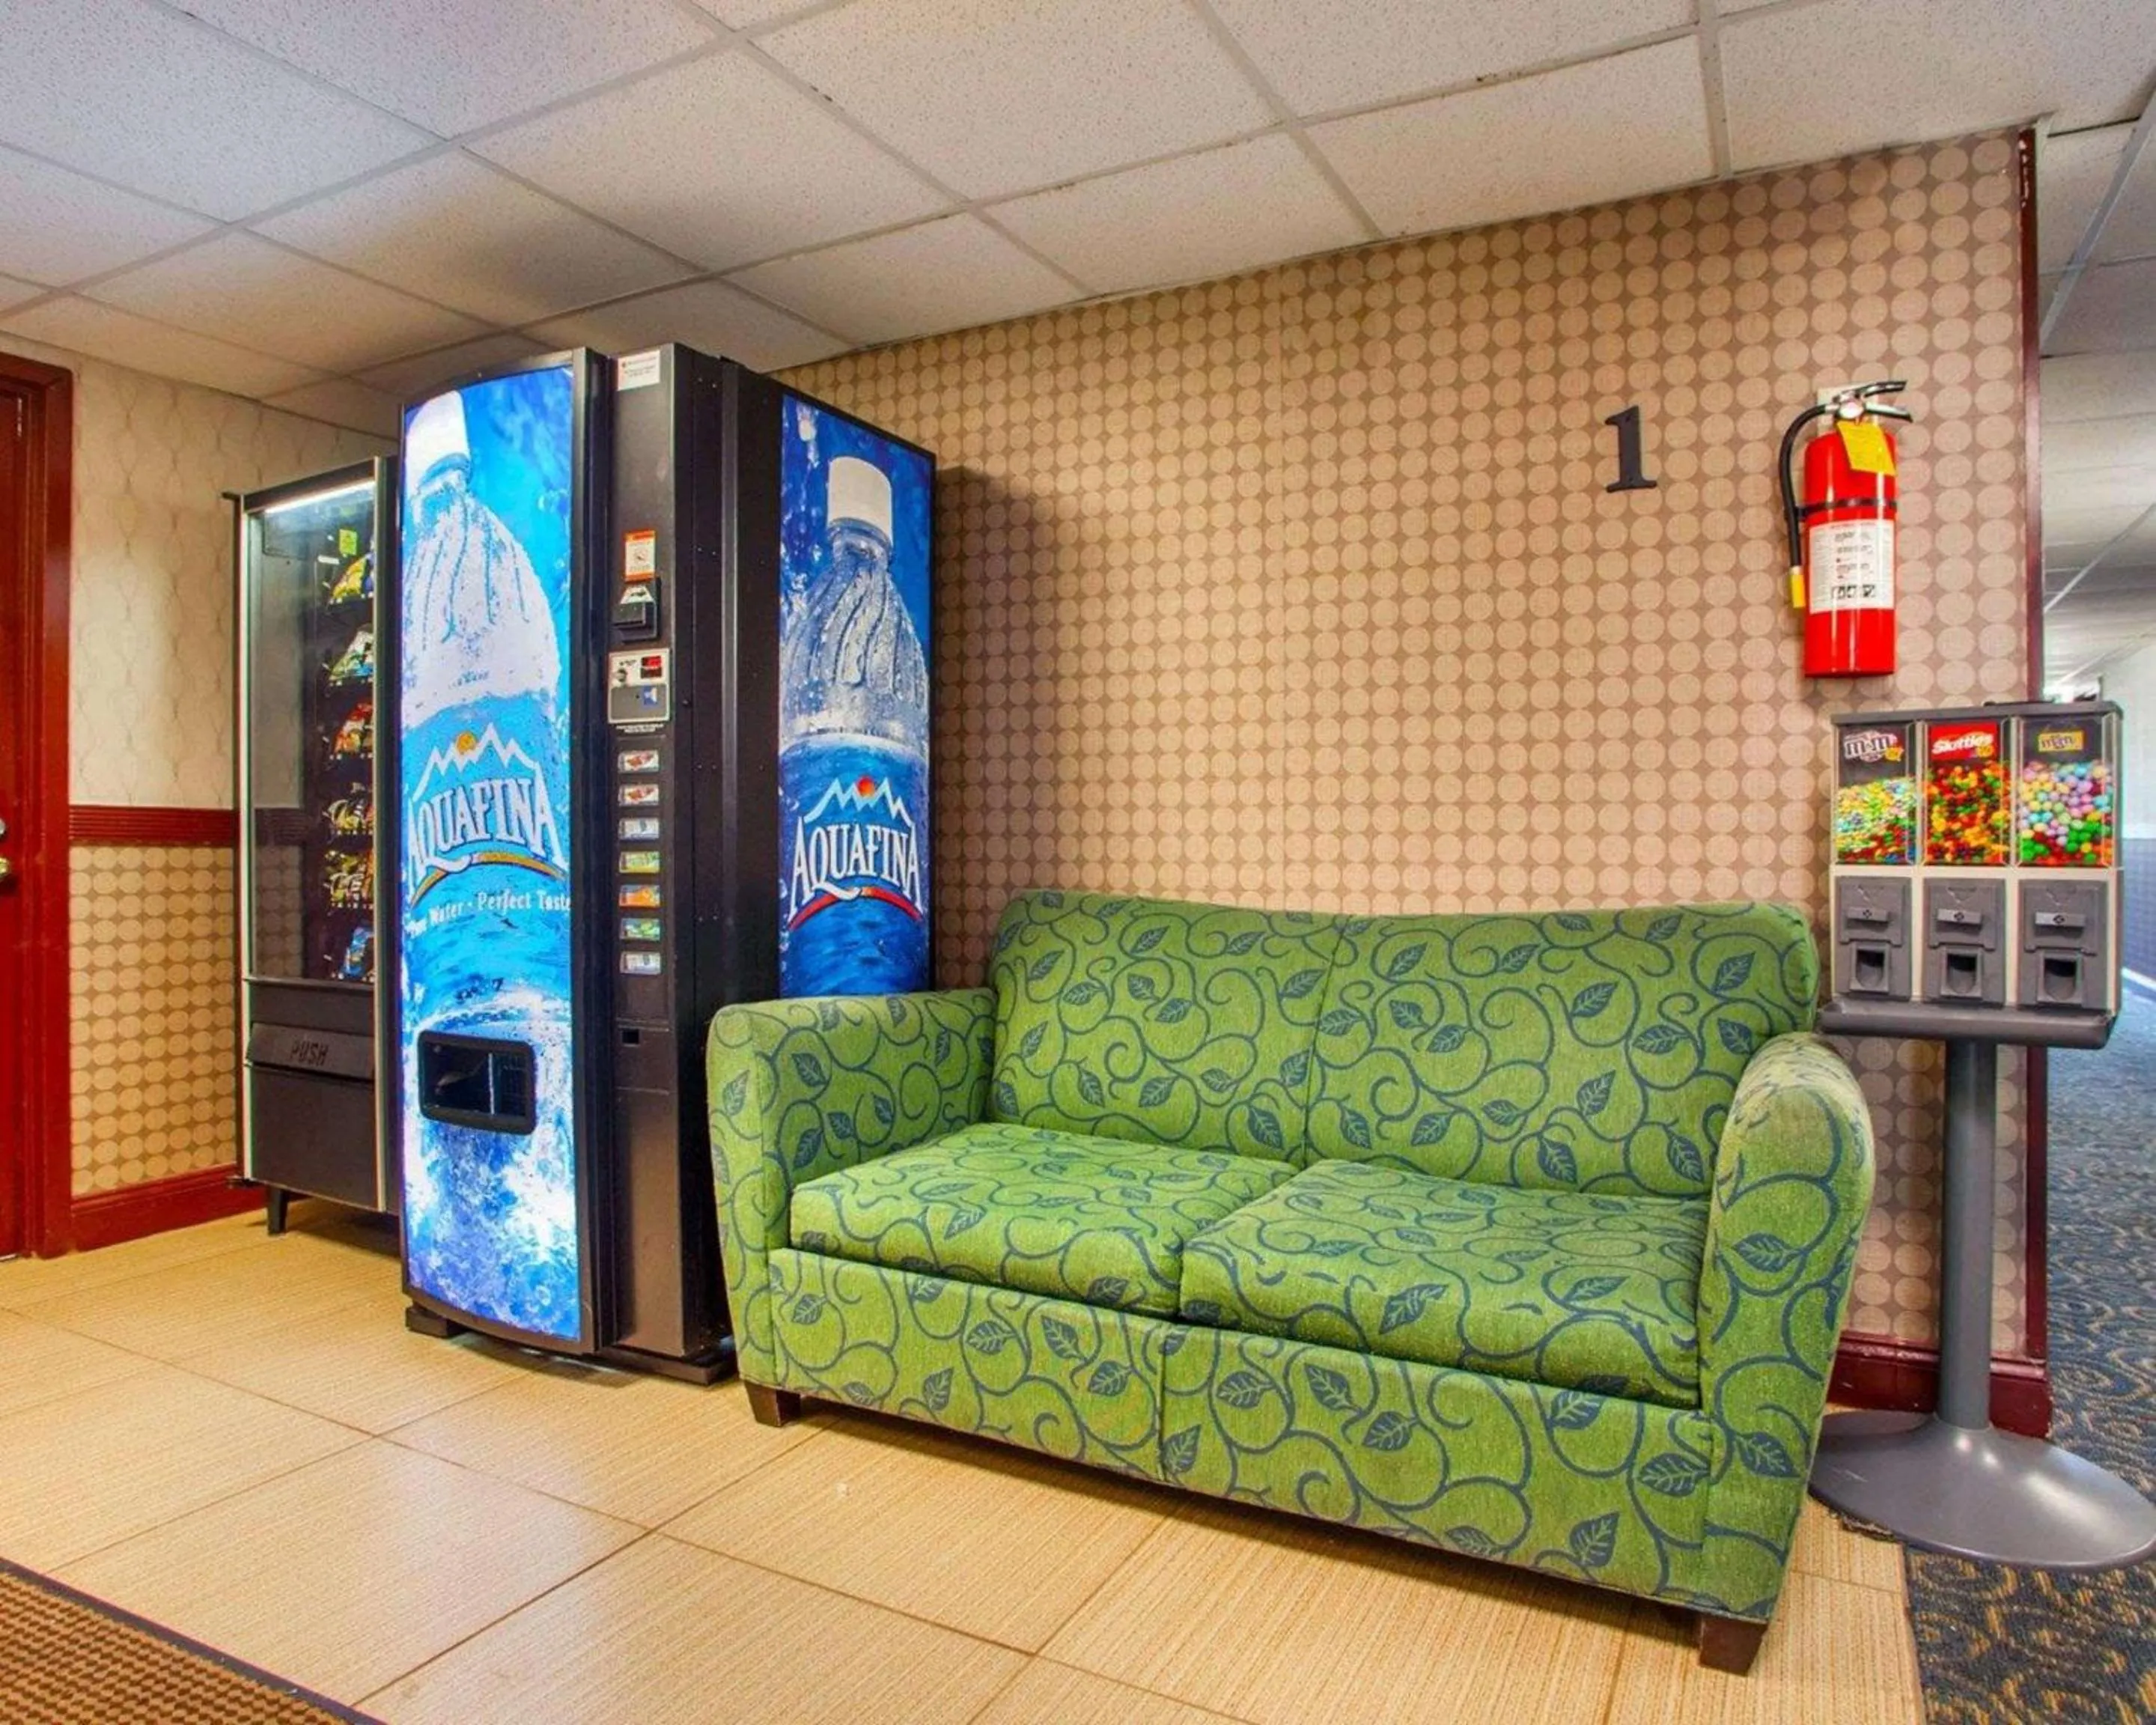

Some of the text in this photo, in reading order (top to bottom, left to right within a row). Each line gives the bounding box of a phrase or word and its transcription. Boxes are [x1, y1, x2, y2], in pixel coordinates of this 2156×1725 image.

[1604, 404, 1657, 493] 1
[408, 770, 569, 904] AQUAFINA
[788, 816, 924, 922] AQUAFINA
[477, 889, 532, 915] Perfect
[290, 1041, 329, 1067] PUSH
